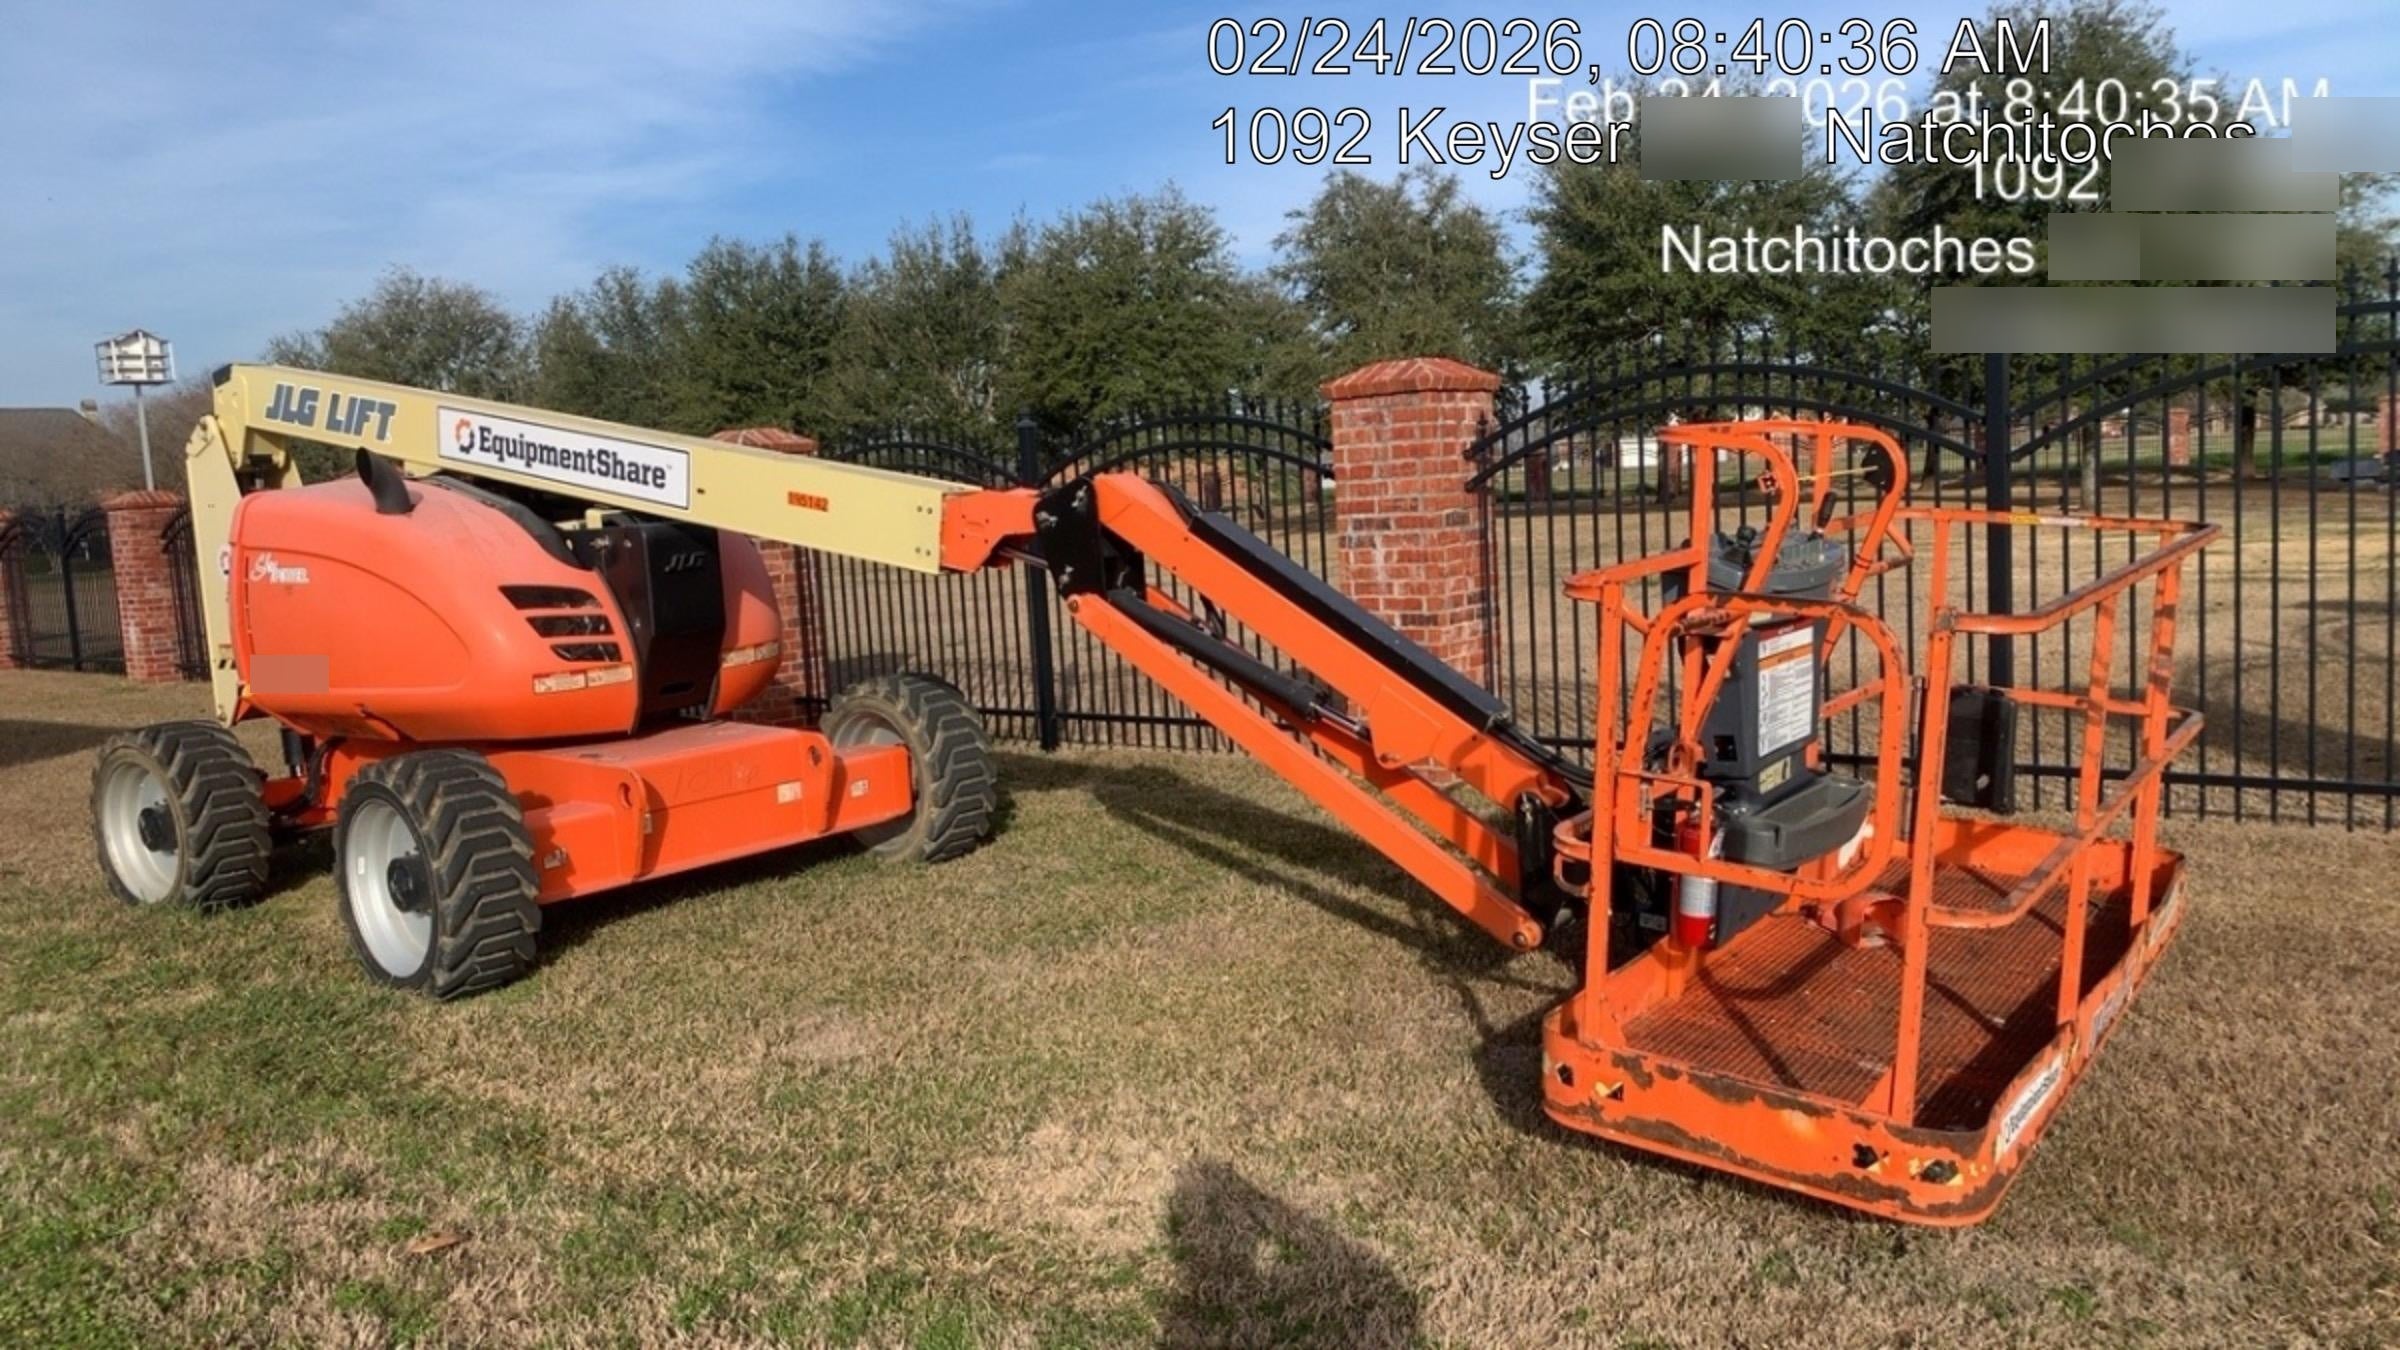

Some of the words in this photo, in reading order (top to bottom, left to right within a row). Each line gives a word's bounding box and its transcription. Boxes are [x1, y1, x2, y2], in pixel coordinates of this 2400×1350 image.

[264, 383, 320, 428] JLG
[325, 392, 397, 443] LIFT
[478, 425, 666, 489] EquipmentShare
